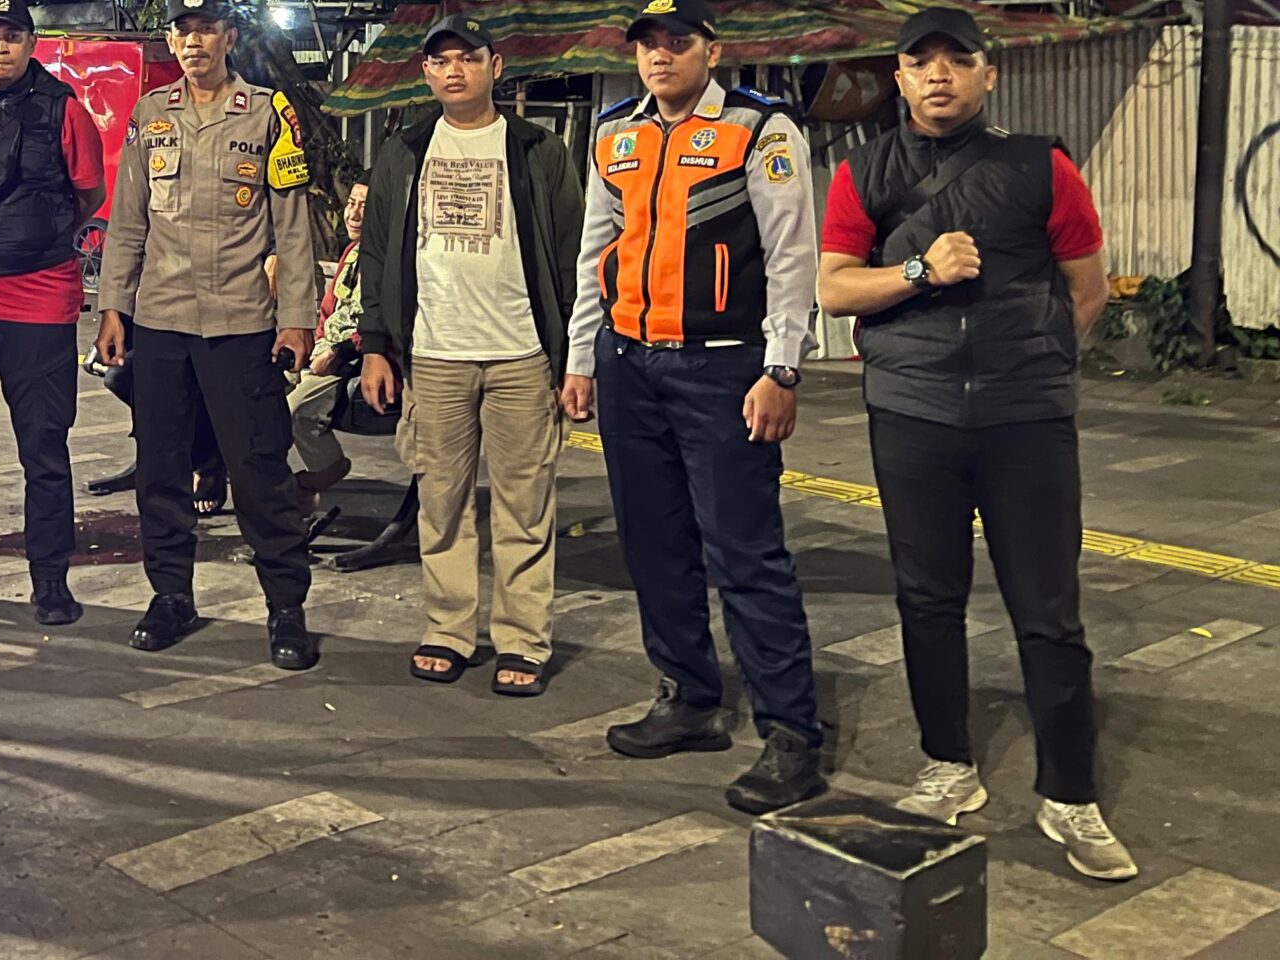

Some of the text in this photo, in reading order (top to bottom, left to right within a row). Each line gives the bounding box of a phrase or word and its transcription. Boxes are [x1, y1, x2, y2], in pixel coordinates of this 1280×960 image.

[450, 161, 468, 169] BEST
[469, 160, 495, 168] VALUE
[680, 156, 715, 166] DISHUB
